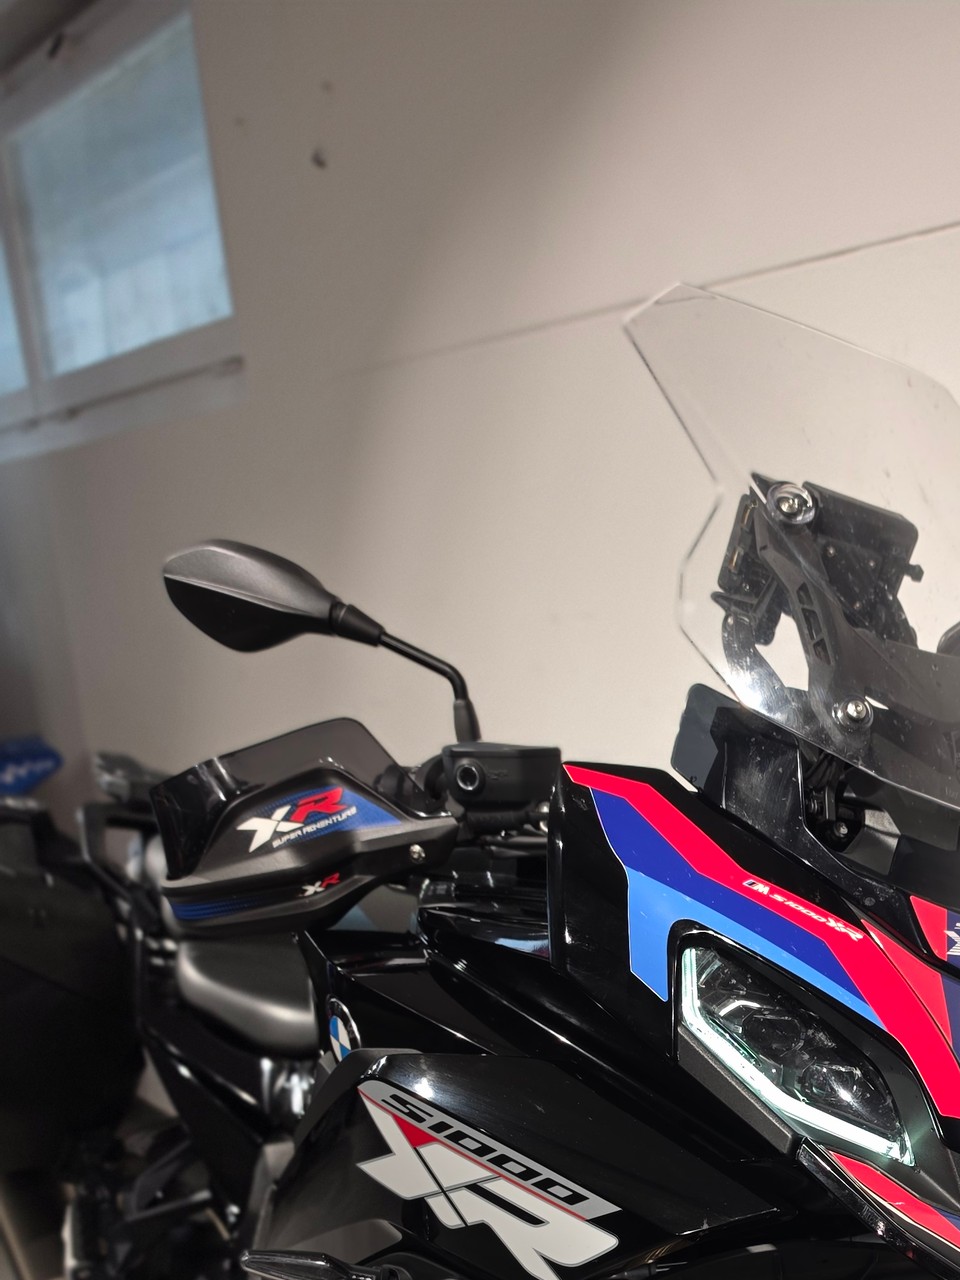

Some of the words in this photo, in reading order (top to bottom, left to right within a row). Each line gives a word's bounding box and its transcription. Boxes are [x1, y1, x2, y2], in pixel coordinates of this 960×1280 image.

[236, 787, 347, 853] XR
[272, 829, 303, 848] SUPER
[302, 872, 340, 896] XR
[381, 1093, 590, 1206] S1000
